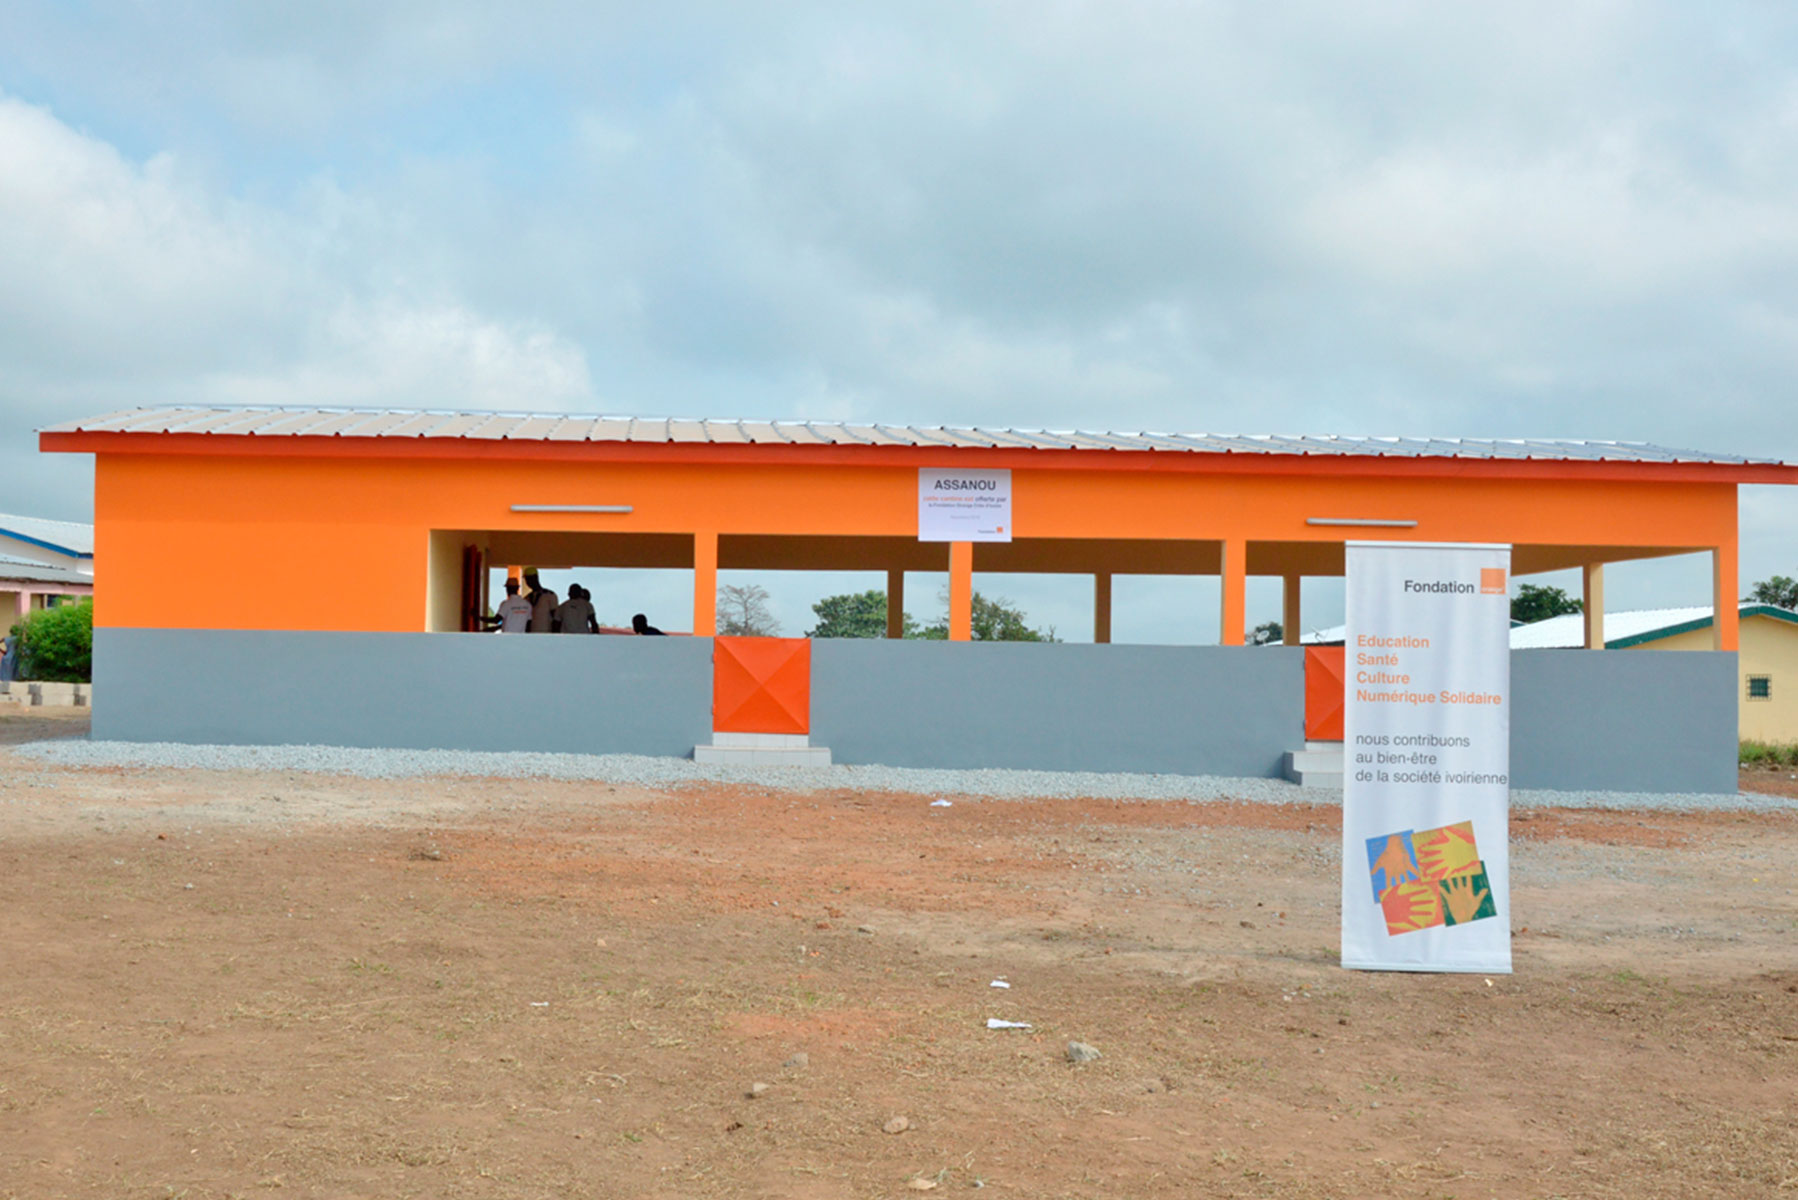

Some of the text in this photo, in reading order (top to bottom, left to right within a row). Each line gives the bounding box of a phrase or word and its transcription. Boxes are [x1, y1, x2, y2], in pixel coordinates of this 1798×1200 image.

[934, 480, 996, 491] ASSANOU
[1404, 580, 1475, 594] Fondation
[1357, 634, 1430, 648] Education
[1356, 652, 1399, 666] Santé
[1356, 671, 1410, 684] Culture
[1356, 689, 1502, 706] Numérique Solidaire
[1356, 734, 1470, 747] nous contribuons
[1355, 751, 1437, 765] au bien-être
[1355, 770, 1507, 785] de la société ivoirienne
